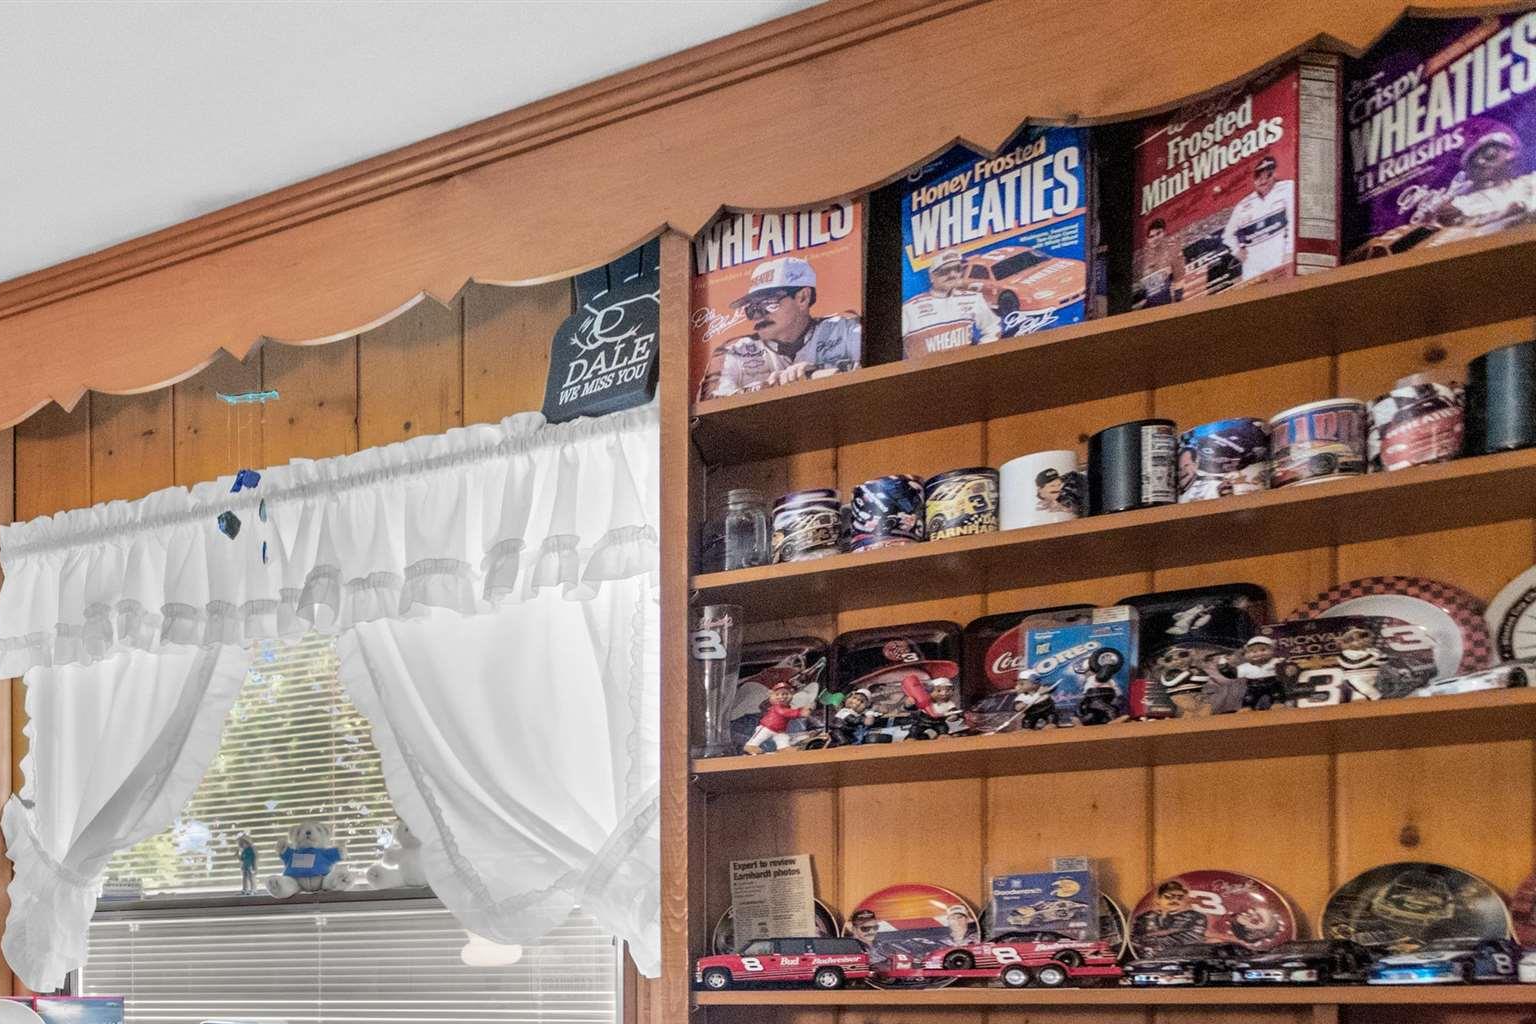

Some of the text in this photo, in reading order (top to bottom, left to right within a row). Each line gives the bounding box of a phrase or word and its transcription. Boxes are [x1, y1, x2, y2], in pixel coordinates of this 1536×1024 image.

[1349, 12, 1536, 173] WHEATIES
[1349, 64, 1425, 123] Crispy
[1167, 95, 1253, 170] Frosted
[1377, 127, 1465, 185] Raisins
[913, 136, 1046, 211] Honey Frosted
[1140, 116, 1285, 216] Mini-Wheats
[910, 146, 1080, 259] WHEATIES
[562, 332, 656, 388] DALE
[924, 325, 973, 354] WHEATIE
[558, 361, 648, 406] WE MISS YOU
[1036, 640, 1101, 676] OREO
[1297, 668, 1345, 709] 3
[1188, 889, 1226, 916] 3
[741, 957, 764, 972] 8
[780, 957, 800, 966] Bud
[992, 947, 1023, 964] 8
[1491, 952, 1513, 975] 8
